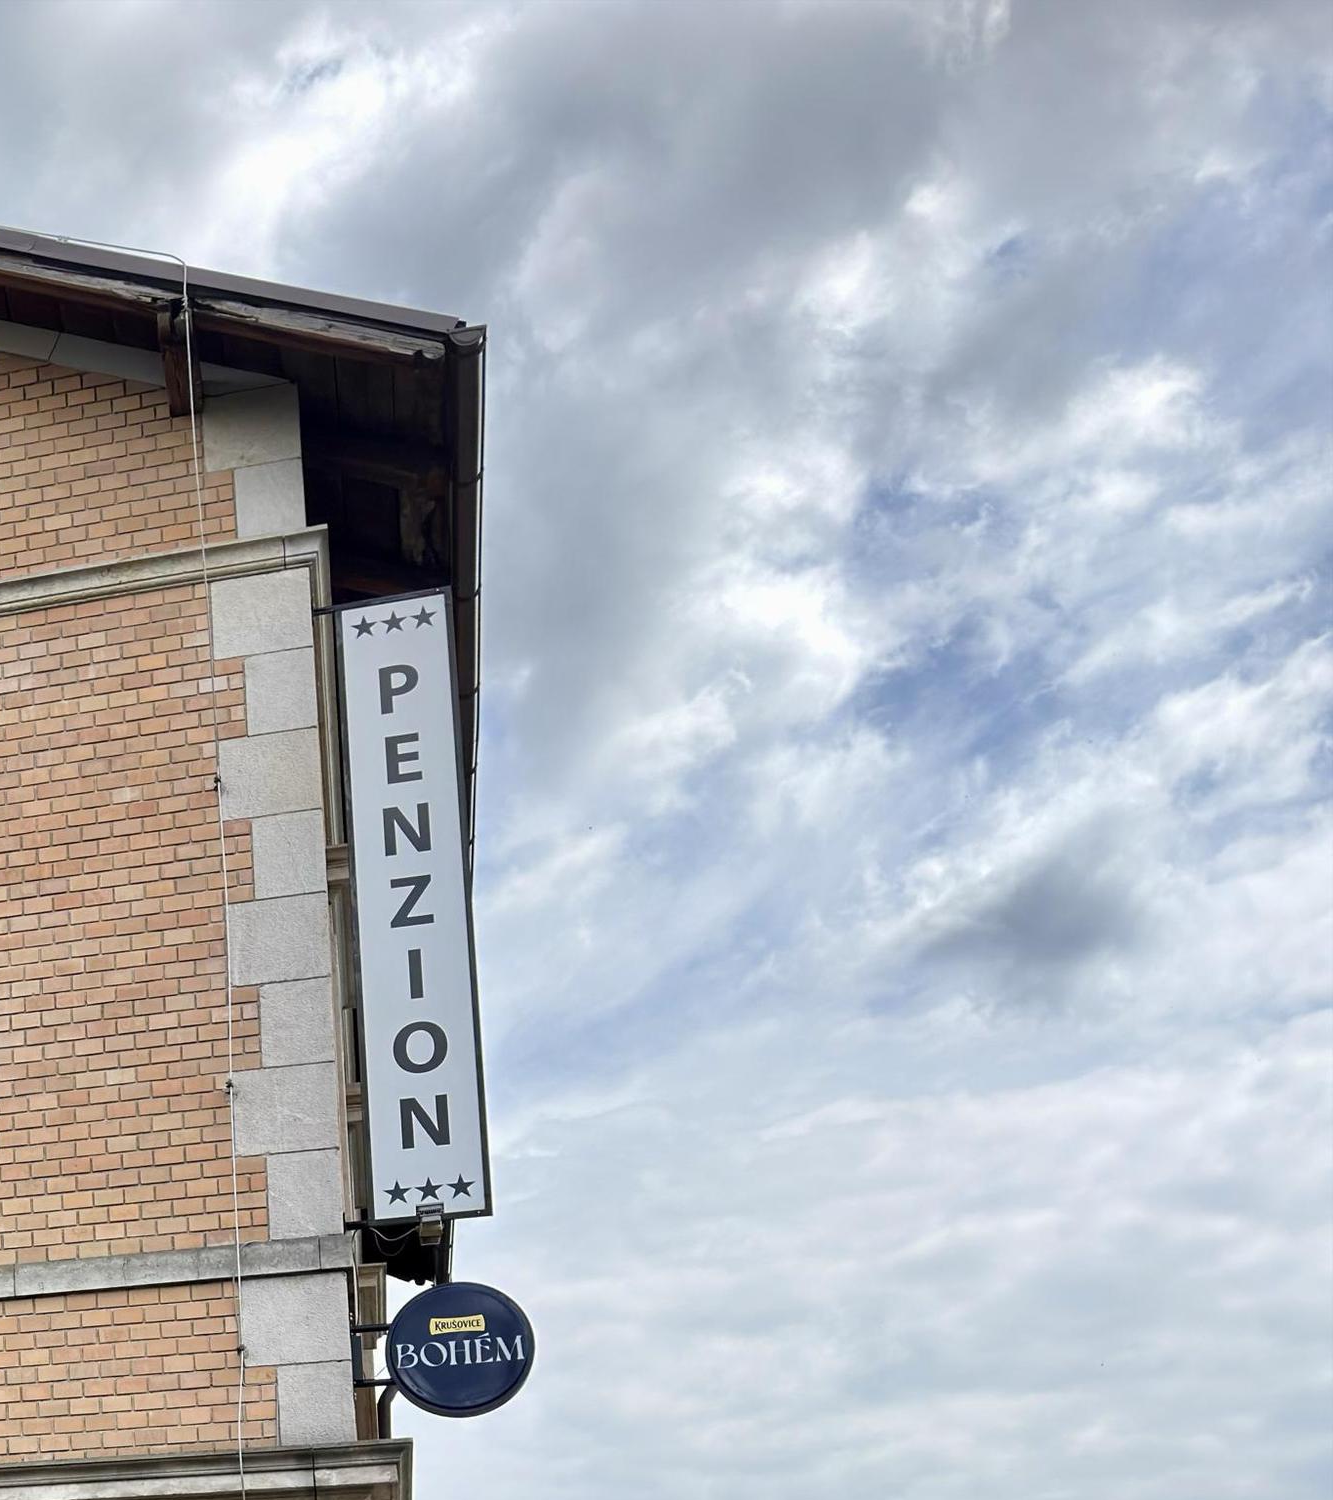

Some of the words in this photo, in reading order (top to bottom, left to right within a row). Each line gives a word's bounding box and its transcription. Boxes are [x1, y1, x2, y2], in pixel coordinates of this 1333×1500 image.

[378, 663, 450, 1150] PENZION
[434, 1318, 482, 1332] KRUŠOVICE
[395, 1332, 525, 1369] BOHÉM
